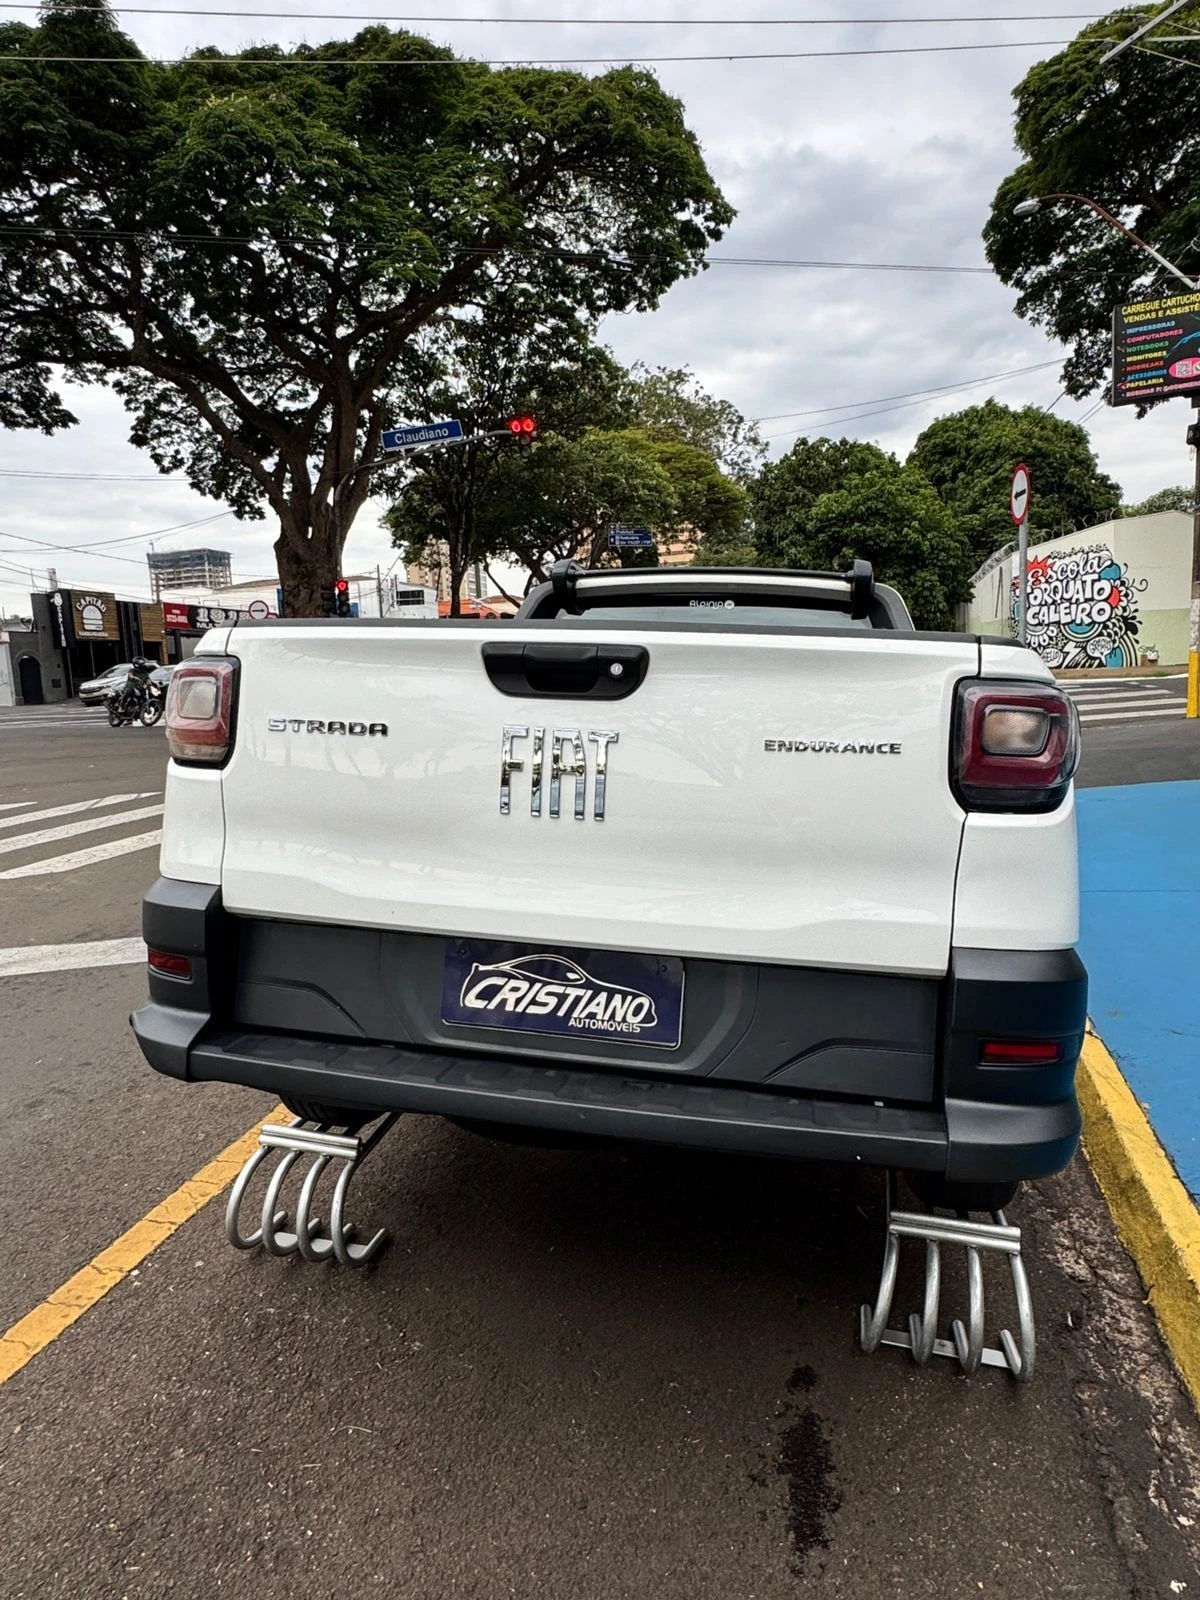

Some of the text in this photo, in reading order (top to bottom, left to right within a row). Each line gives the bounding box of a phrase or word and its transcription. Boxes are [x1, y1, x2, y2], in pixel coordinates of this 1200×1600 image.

[1122, 300, 1160, 315] CARREGUE
[1124, 311, 1157, 324] VENDAS
[1158, 310, 1163, 318] E
[1126, 320, 1176, 334] IMPRESSORAS
[1126, 329, 1184, 343] COMPUTADORES
[1126, 341, 1169, 353] NOTEBOOKS
[1126, 351, 1167, 362] MONITORES
[1126, 360, 1164, 371] NOBREAKS
[1126, 378, 1164, 388] PAPELARIA
[394, 427, 449, 444] Claudiano
[1027, 553, 1112, 587] Escola
[1026, 601, 1112, 626] CALEIRO
[268, 718, 389, 737] STRADA
[764, 739, 902, 754] ENDURANCE
[500, 724, 620, 822] FIAT
[464, 976, 650, 1024] CRISTIANO
[568, 1018, 641, 1033] AUTOMÓVEIS
